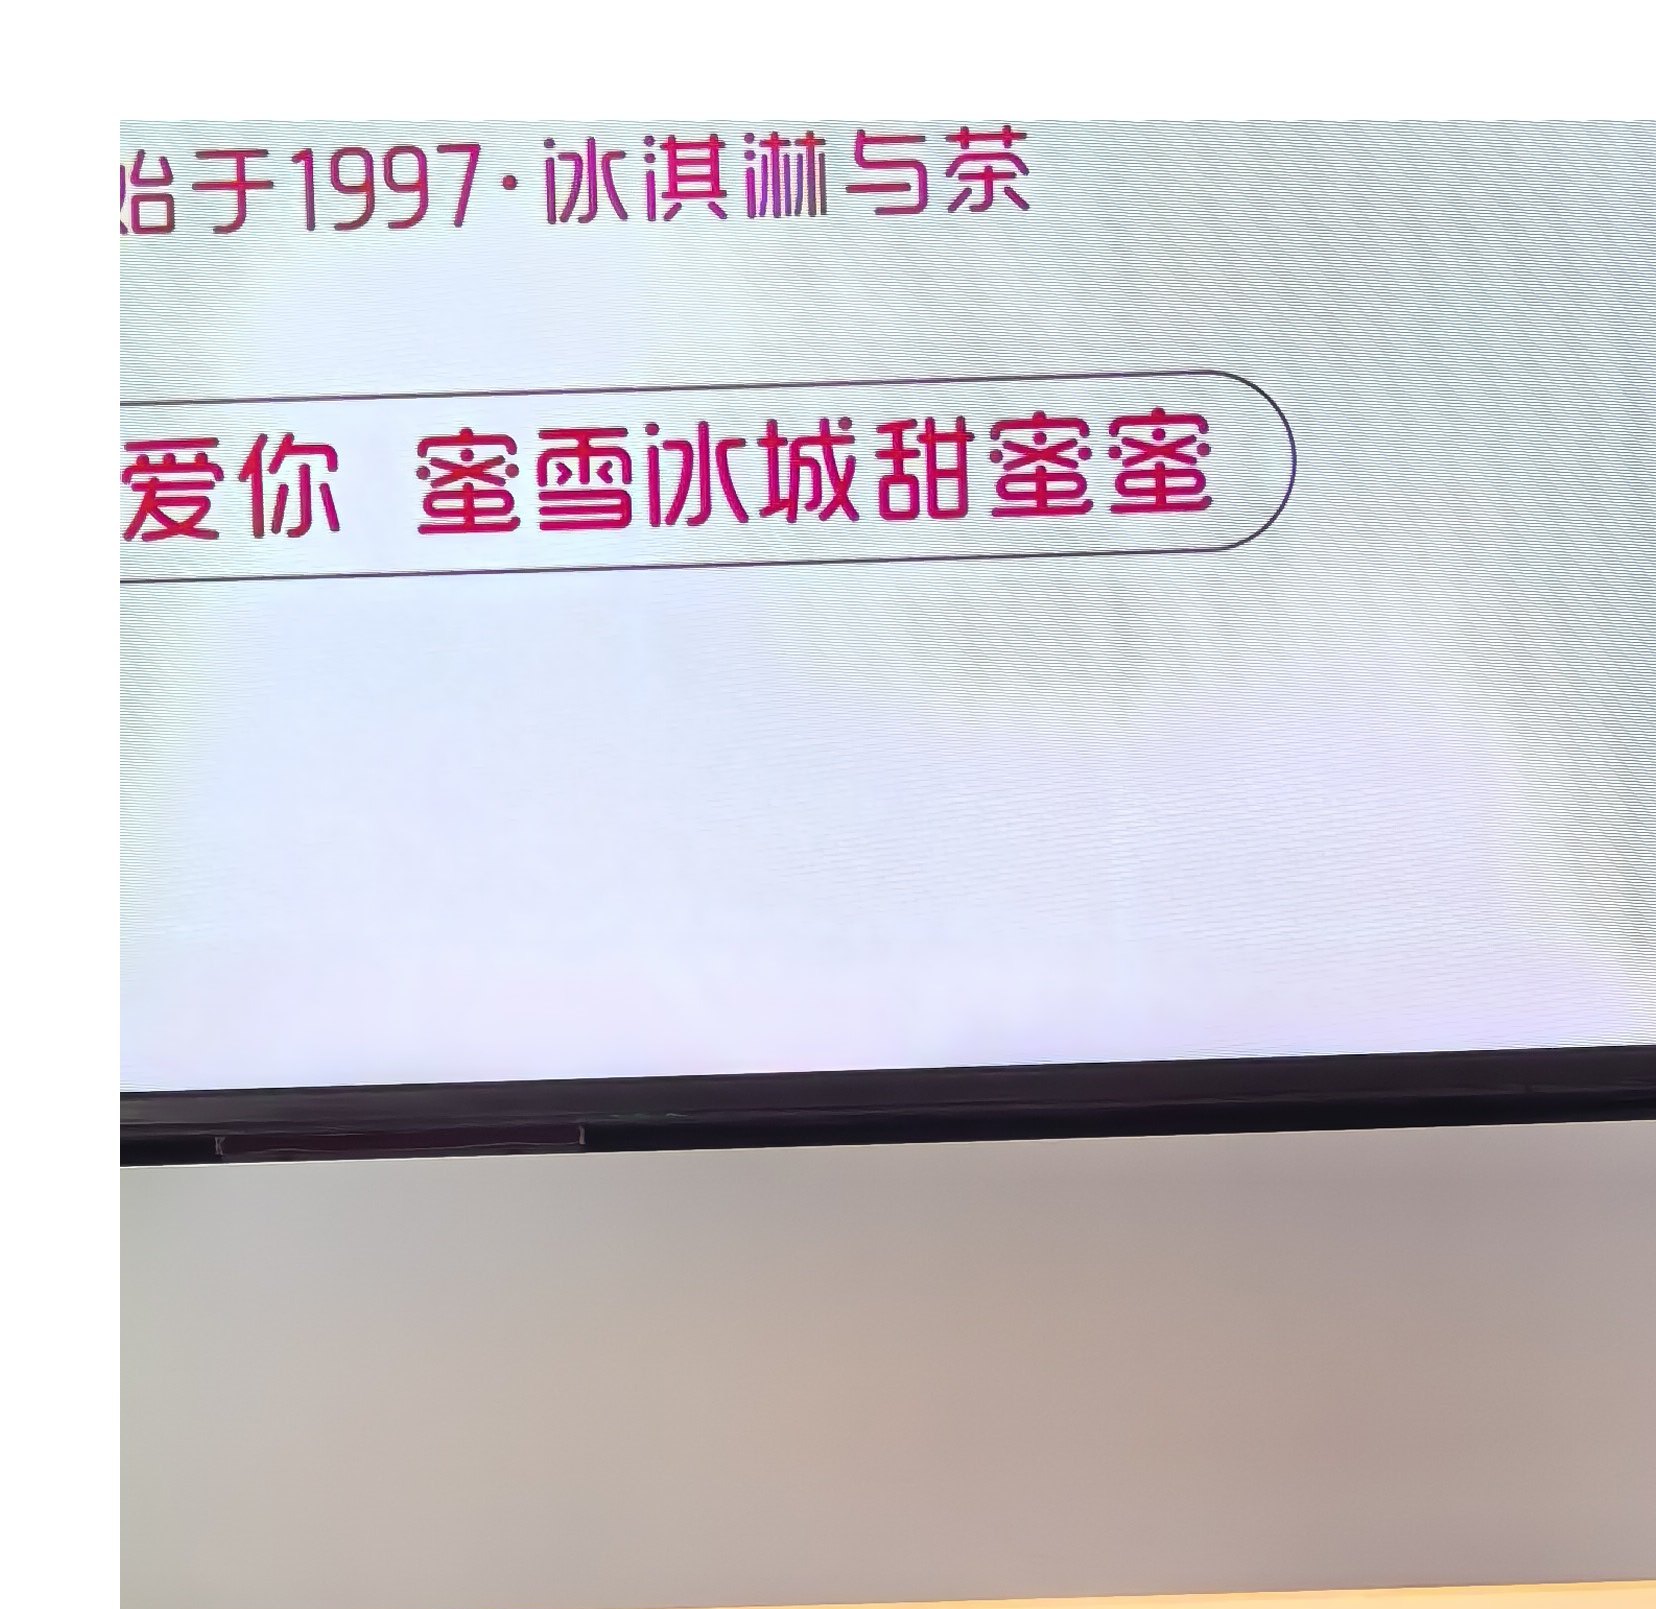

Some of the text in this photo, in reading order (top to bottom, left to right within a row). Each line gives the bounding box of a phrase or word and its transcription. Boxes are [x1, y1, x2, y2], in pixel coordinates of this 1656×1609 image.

[122, 407, 1214, 542] 爱你 蜜雪冰城甜蜜蜜
